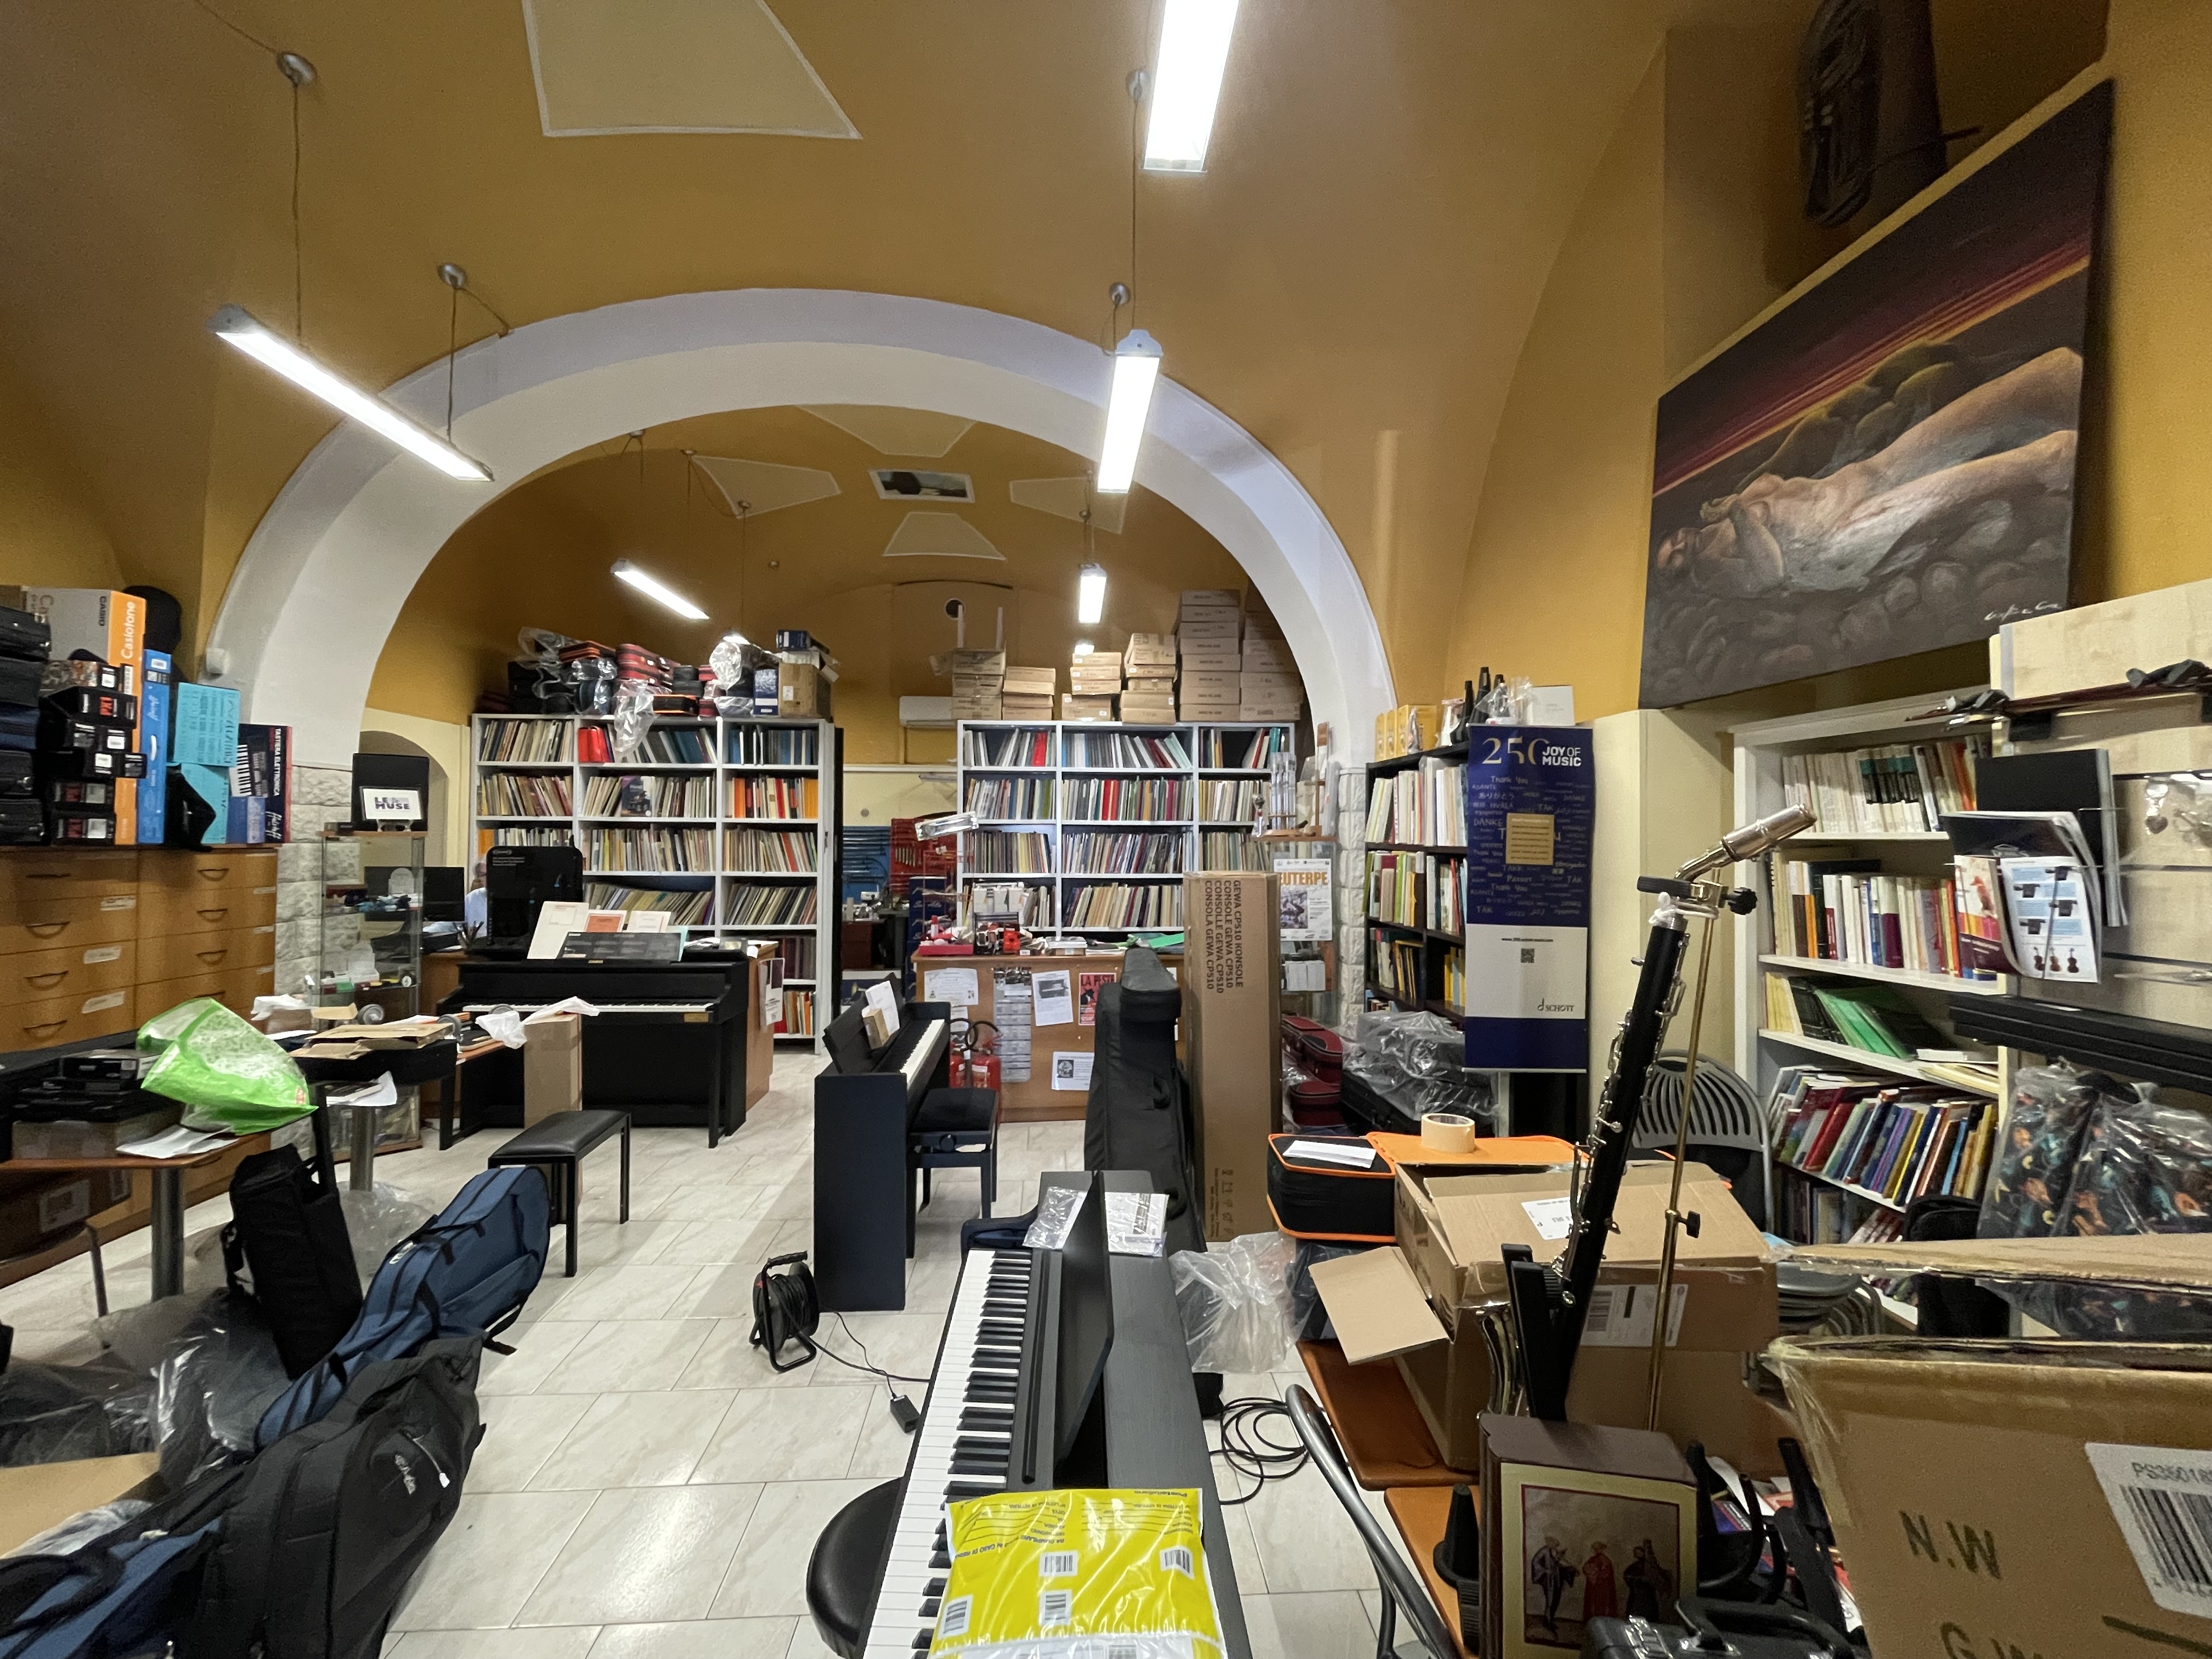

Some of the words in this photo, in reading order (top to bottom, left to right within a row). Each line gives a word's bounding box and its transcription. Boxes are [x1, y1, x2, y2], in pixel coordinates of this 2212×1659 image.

[98, 596, 107, 627] CASIO
[120, 601, 136, 659] Casiotone
[1542, 746, 1565, 757] JOY
[1566, 747, 1581, 757] OF
[1542, 756, 1582, 767] MUSIC
[1205, 880, 1213, 927] CONSOLA
[1215, 880, 1223, 930] CONSOLLE
[1224, 880, 1232, 925] CONSOLE
[1233, 879, 1242, 909] GEWA
[1234, 911, 1242, 940] CP510
[1081, 974, 1091, 986] LA
[1206, 960, 1215, 990] CP510
[1235, 943, 1243, 988] KONSOLE
[1899, 1510, 2001, 1580] N.W
